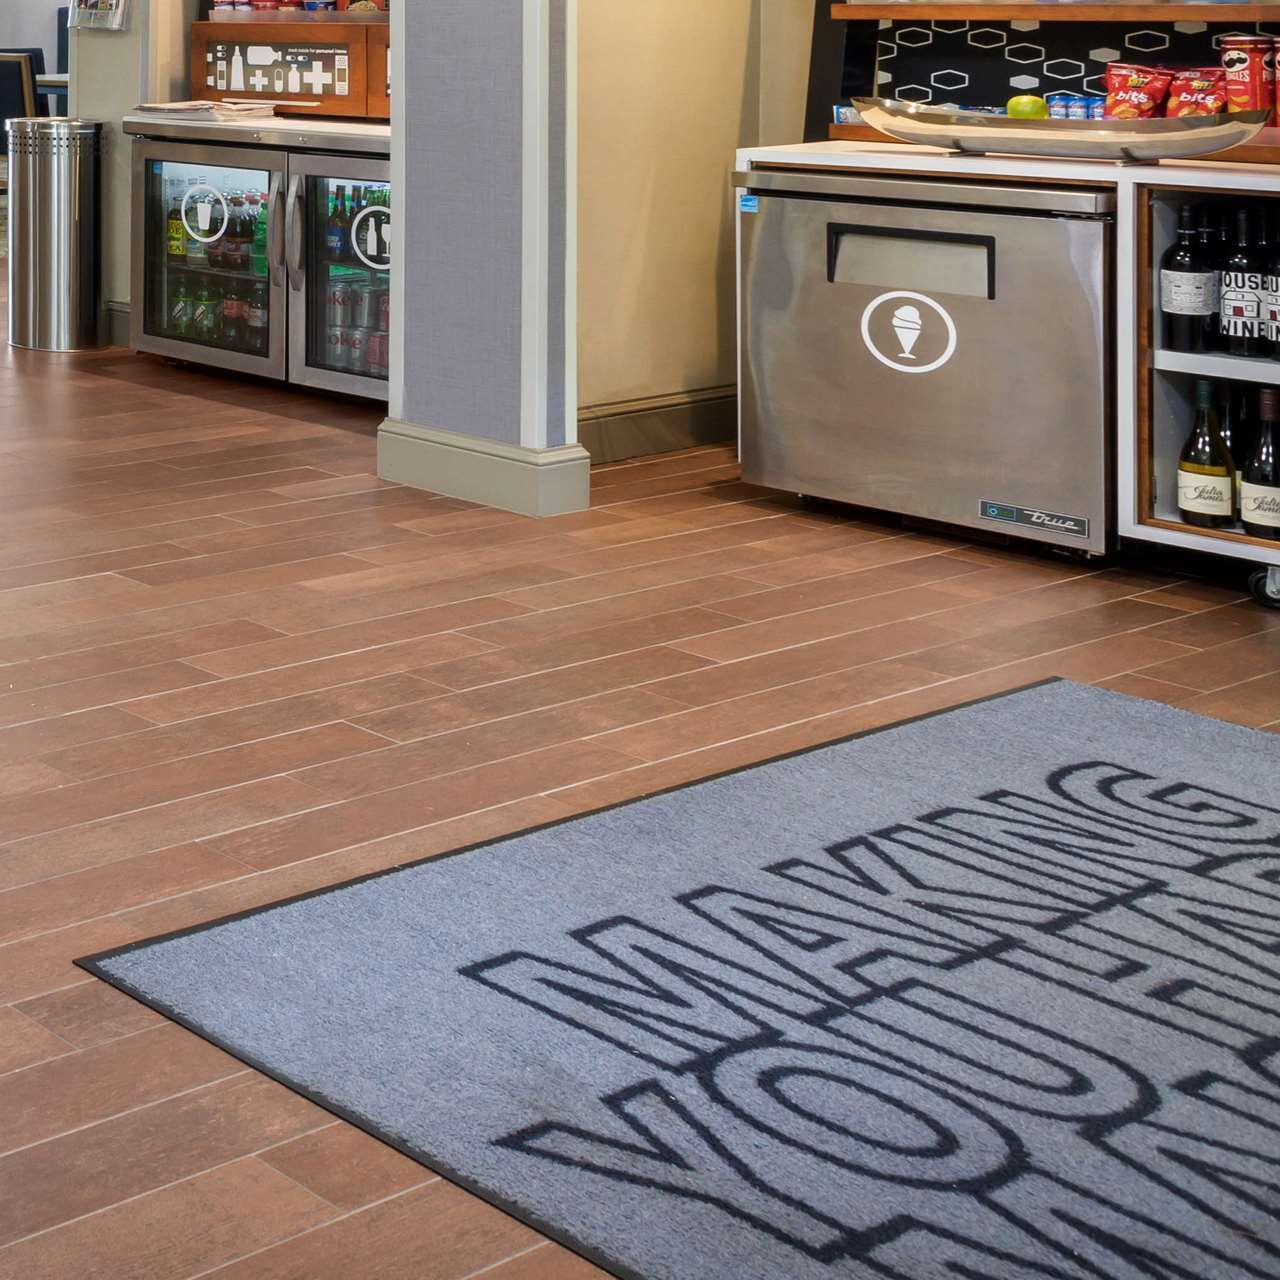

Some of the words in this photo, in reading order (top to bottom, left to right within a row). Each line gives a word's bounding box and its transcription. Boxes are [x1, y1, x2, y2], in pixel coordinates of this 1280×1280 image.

[1115, 90, 1148, 104] bits
[1179, 91, 1215, 105] bits
[1220, 270, 1269, 293] OUSE
[1023, 510, 1080, 530] true
[455, 758, 1280, 1073] MAKING
[488, 970, 1162, 1265] YOU
